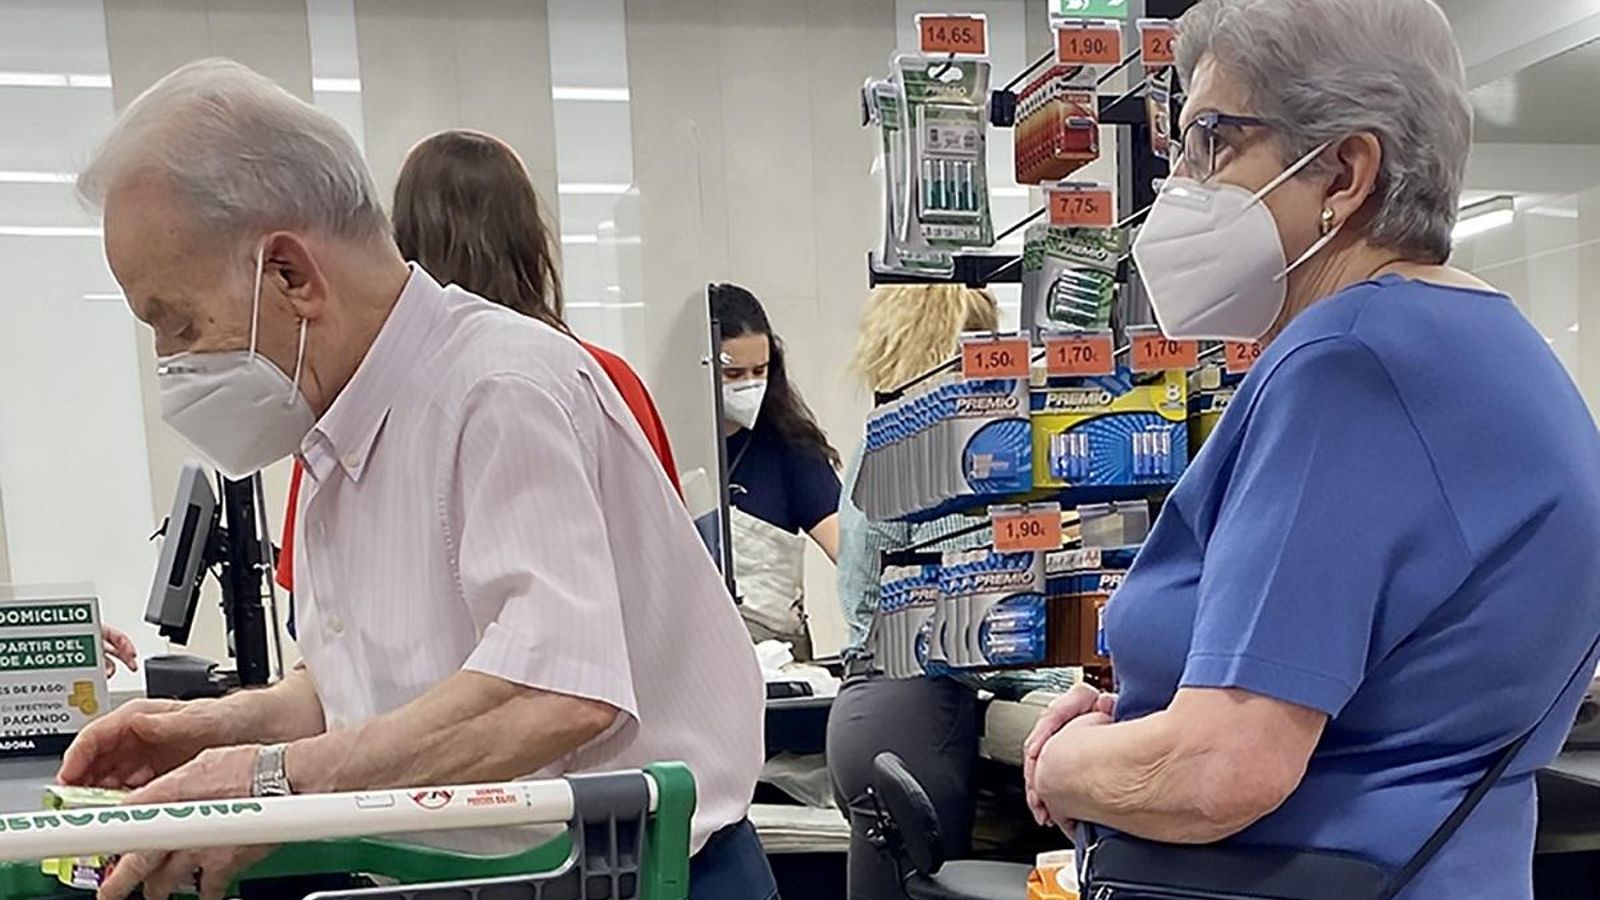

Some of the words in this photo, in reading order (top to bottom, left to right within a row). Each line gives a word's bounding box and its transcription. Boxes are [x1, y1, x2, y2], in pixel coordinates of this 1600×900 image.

[1047, 391, 1112, 409] PREMIO
[1166, 384, 1180, 401] 8
[957, 396, 1018, 413] PREMIO
[974, 571, 1035, 587] PREMIO
[55, 639, 84, 650] DEL
[0, 655, 20, 667] DE
[24, 652, 86, 666] AGOSTO
[13, 686, 28, 694] DE
[3, 713, 70, 726] PAGANDO
